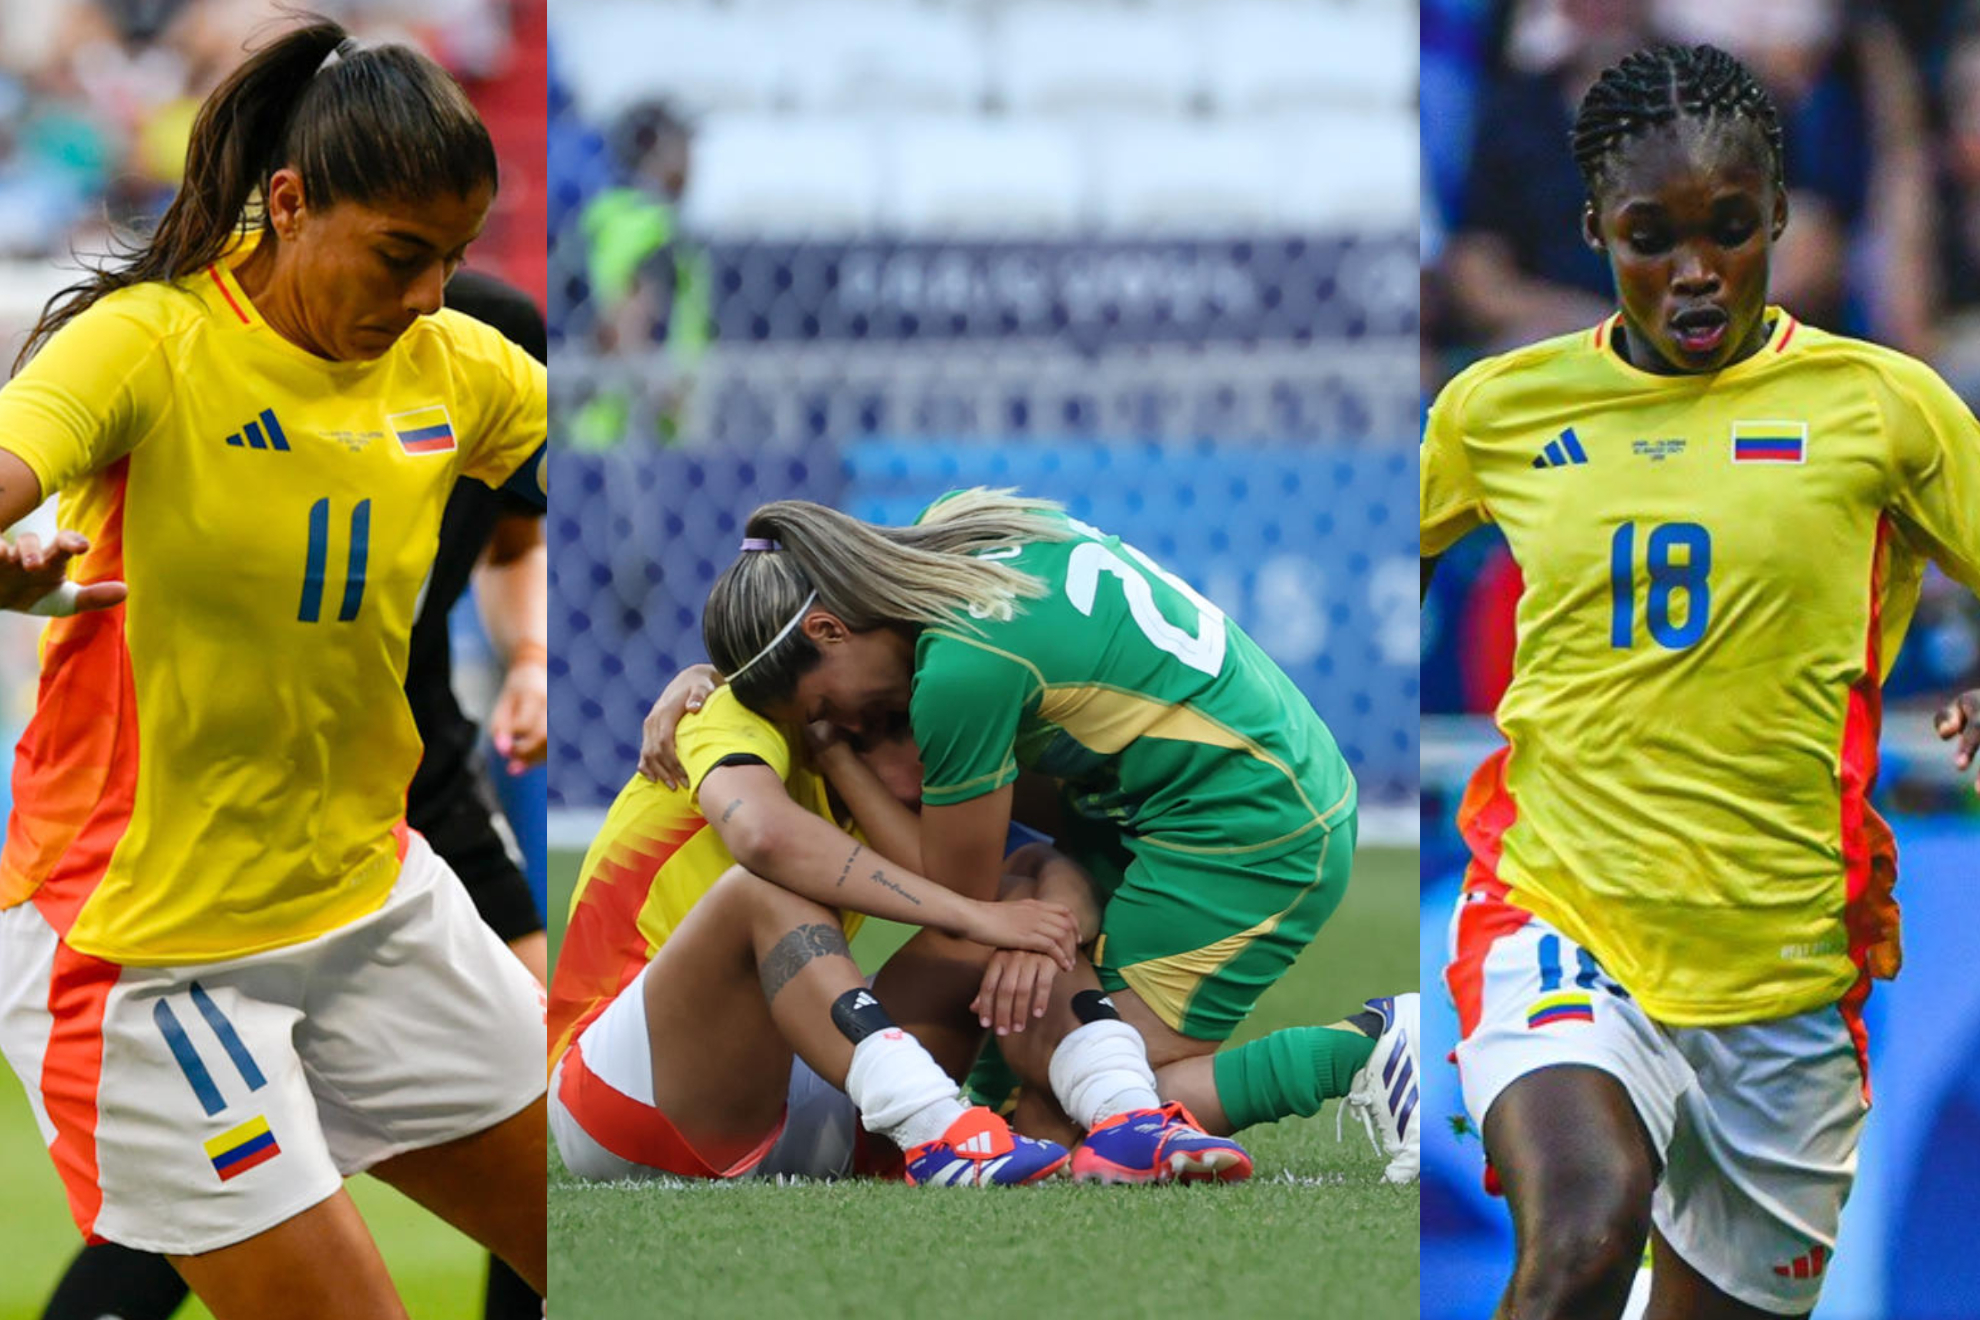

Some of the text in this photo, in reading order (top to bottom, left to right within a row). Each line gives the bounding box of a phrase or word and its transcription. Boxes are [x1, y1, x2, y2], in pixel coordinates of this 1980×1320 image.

[297, 497, 371, 623] 11
[1065, 516, 1226, 678] 2
[1610, 521, 1712, 650] 18
[153, 980, 267, 1117] 11
